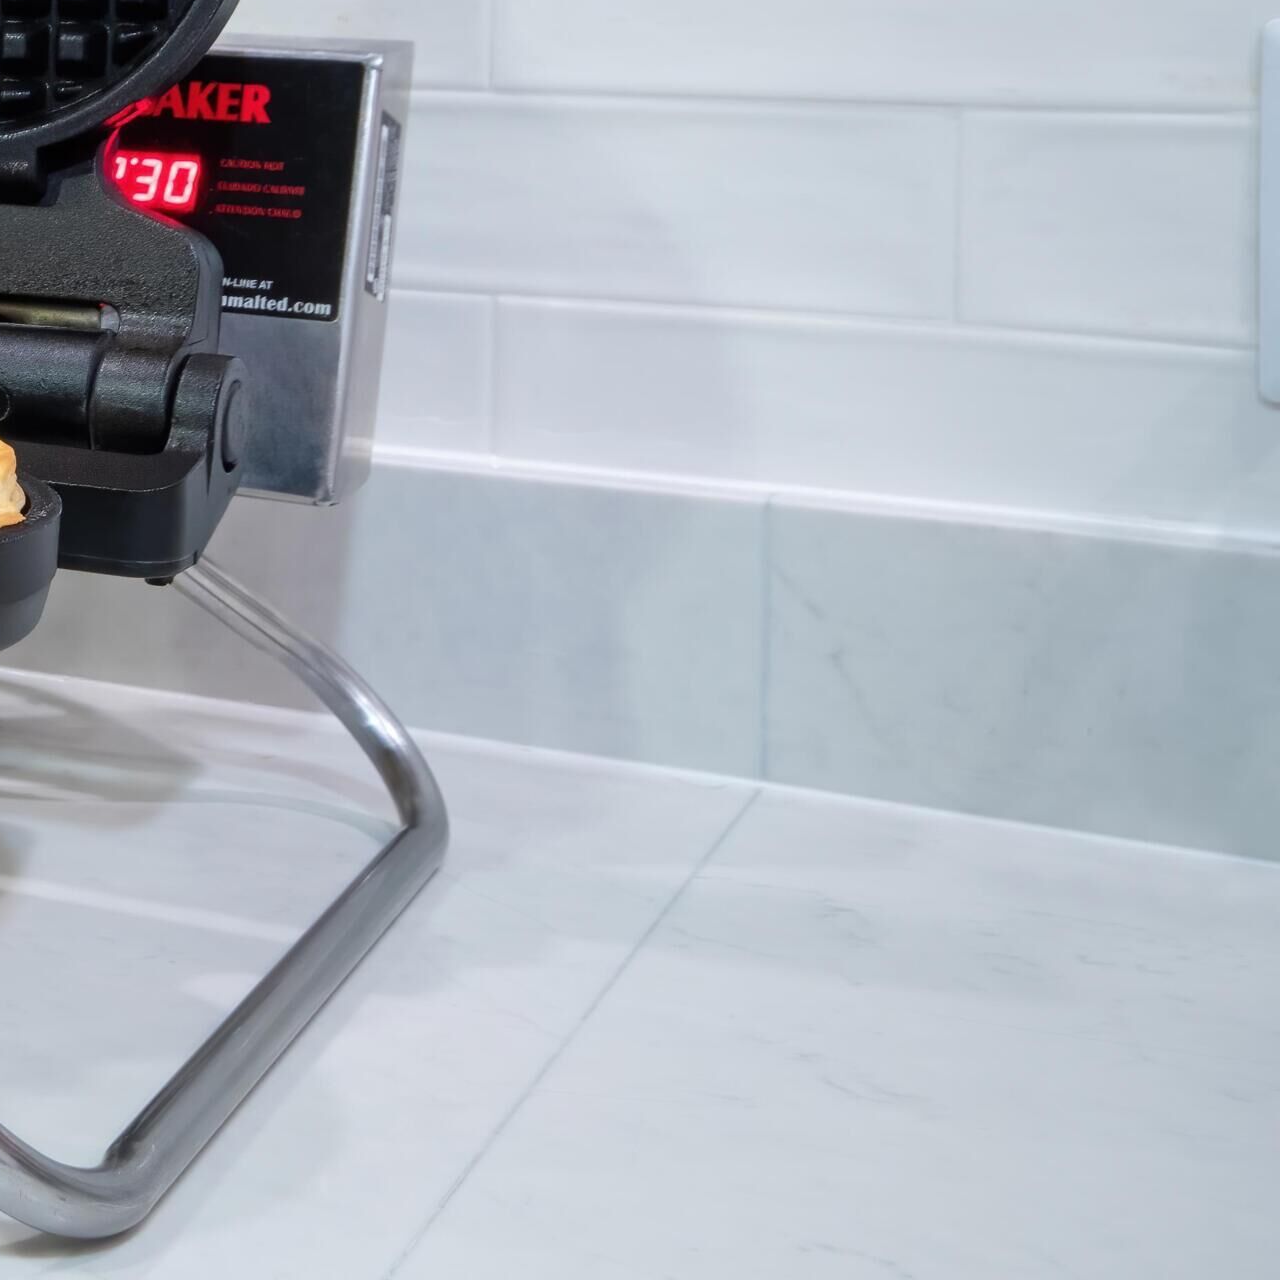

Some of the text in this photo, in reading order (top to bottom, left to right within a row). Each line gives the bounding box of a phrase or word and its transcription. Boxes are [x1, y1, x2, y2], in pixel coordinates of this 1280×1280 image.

[140, 80, 272, 124] AKER
[222, 277, 274, 290] N-LINE AT
